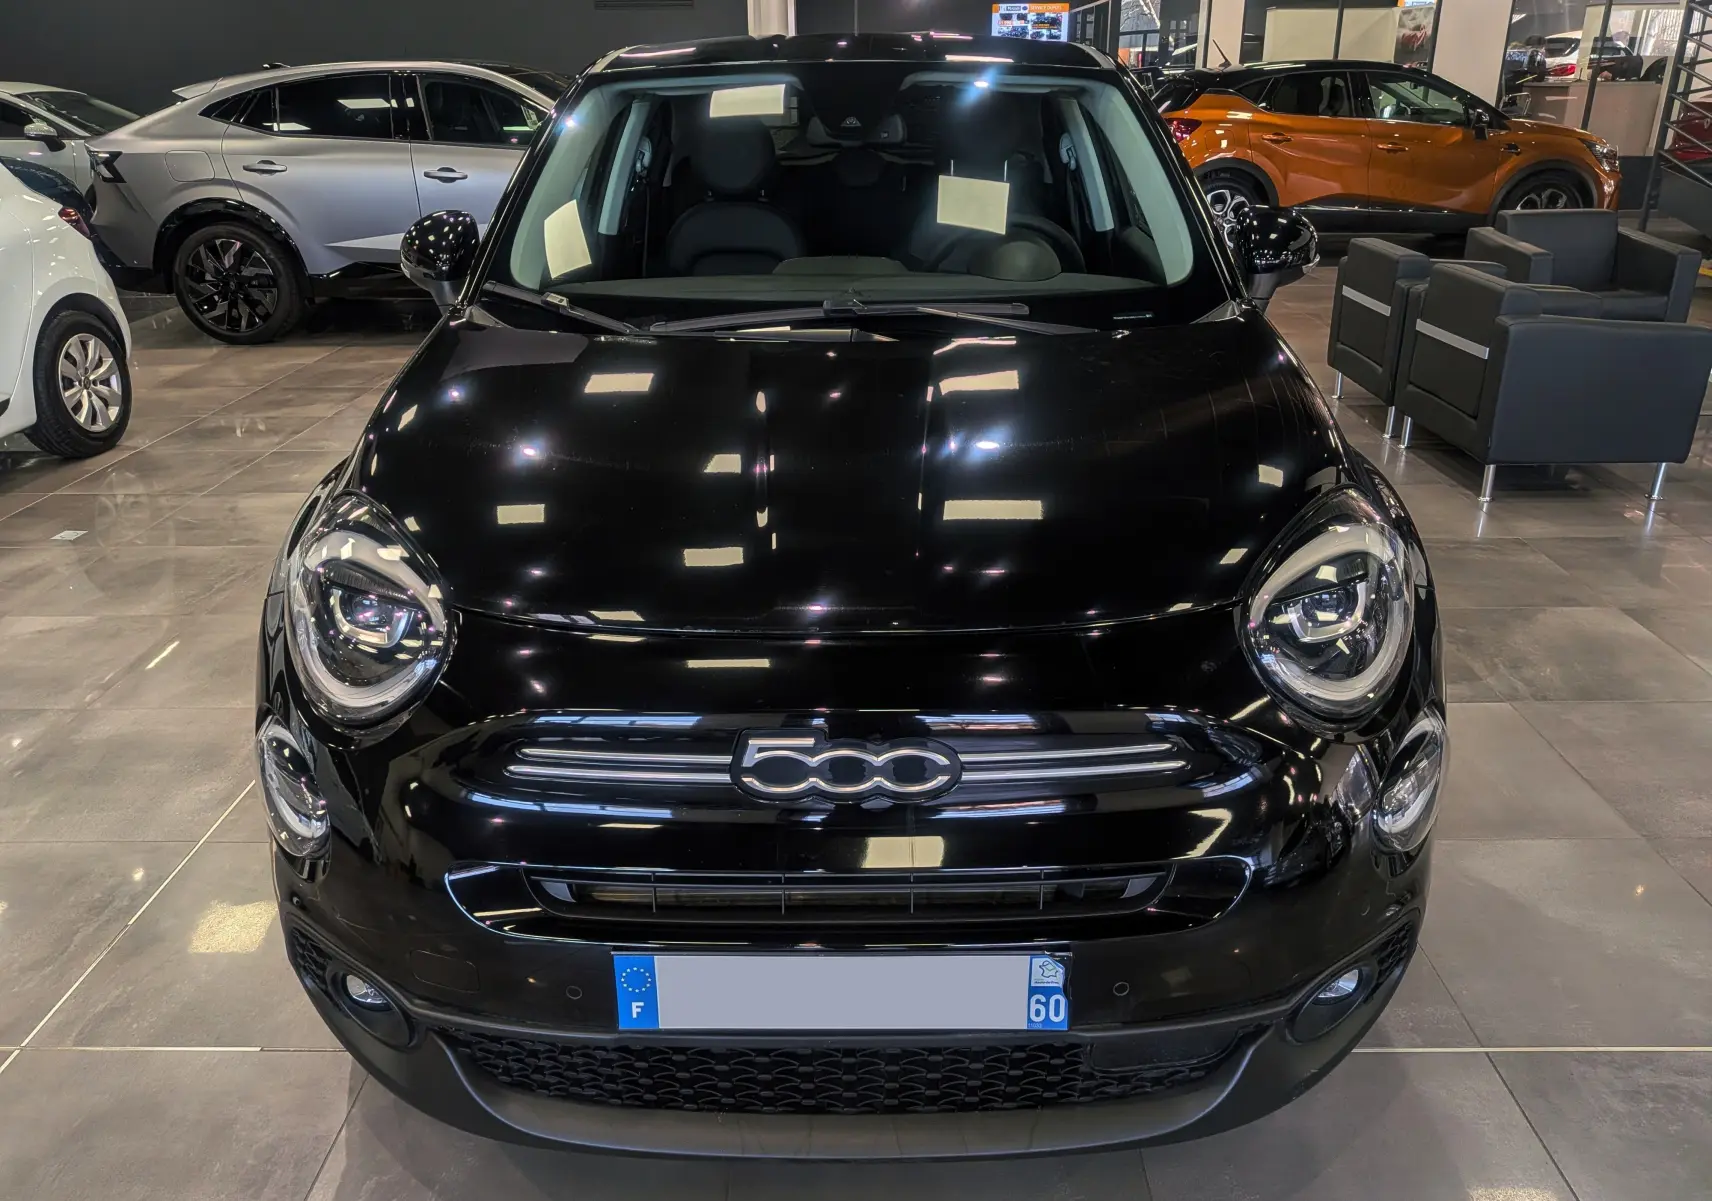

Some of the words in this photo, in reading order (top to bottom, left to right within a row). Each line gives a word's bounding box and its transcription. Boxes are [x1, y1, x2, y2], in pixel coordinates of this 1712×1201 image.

[741, 737, 951, 794] 500
[631, 1001, 645, 1019] F
[1029, 994, 1066, 1023] 60
